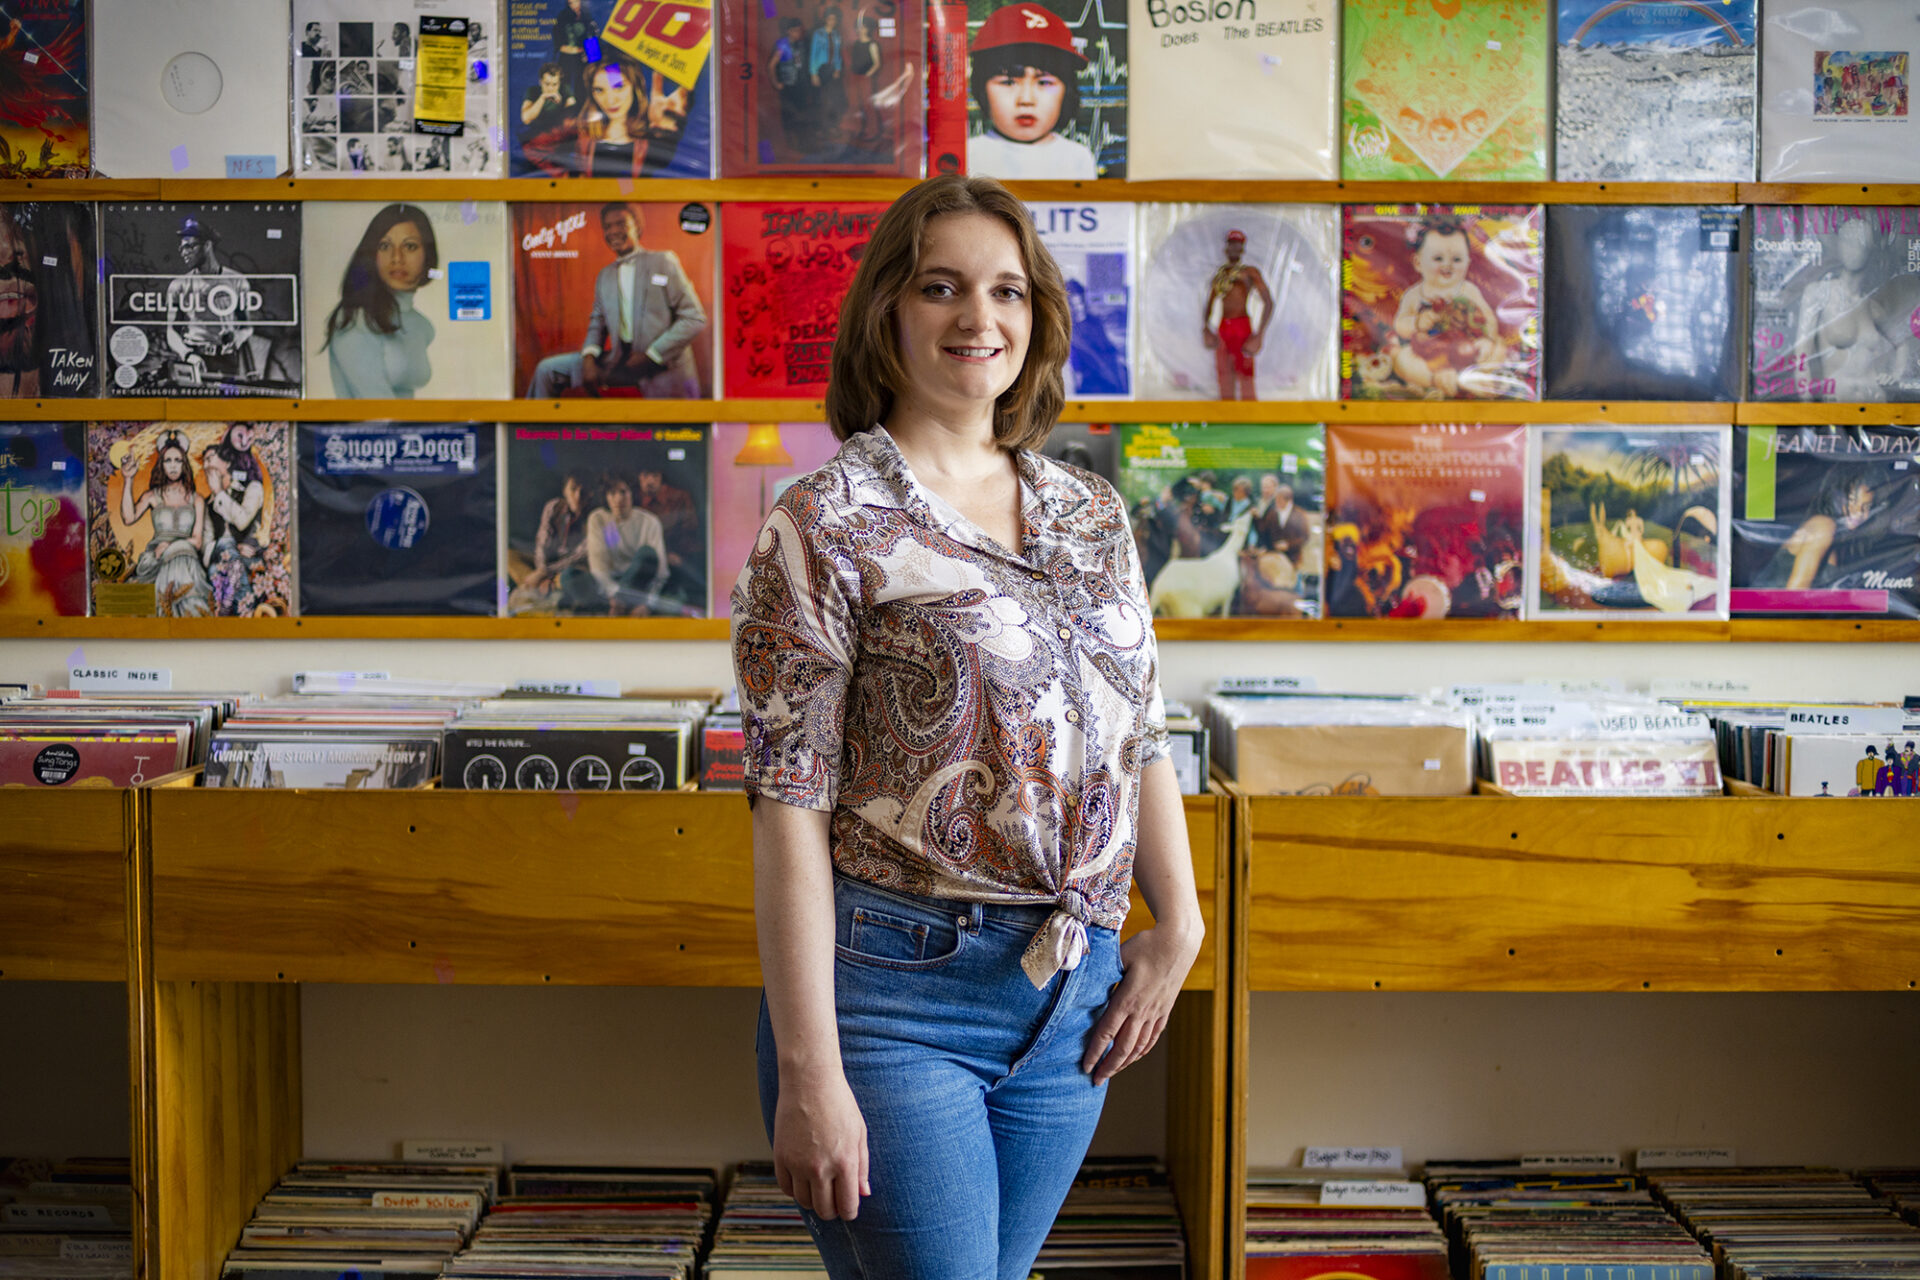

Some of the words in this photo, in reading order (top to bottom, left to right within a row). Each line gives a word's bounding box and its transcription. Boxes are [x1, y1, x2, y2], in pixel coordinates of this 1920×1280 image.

[1160, 32, 1200, 48] Does
[1224, 26, 1250, 40] The
[1255, 18, 1324, 37] BEATLES
[739, 62, 753, 80] 3
[232, 159, 264, 175] NFS
[128, 284, 263, 317] CELLULOID
[1755, 327, 1785, 350] So
[1754, 351, 1808, 373] Last
[1754, 374, 1837, 396] Season
[619, 428, 653, 441] Mind
[324, 434, 397, 465] Snoop
[400, 433, 464, 463] Dogg
[1763, 434, 1842, 461] JEANET
[1862, 569, 1915, 589] Muna
[73, 669, 118, 678] CLASSIC
[127, 671, 159, 681] INDIE
[1600, 714, 1638, 731] USED
[1643, 714, 1701, 731] BEATLES
[1790, 713, 1850, 726] BEATLES
[213, 749, 260, 763] (WHAT'S
[1499, 760, 1666, 787] BEATLES
[37, 1208, 96, 1218] RECORDS
